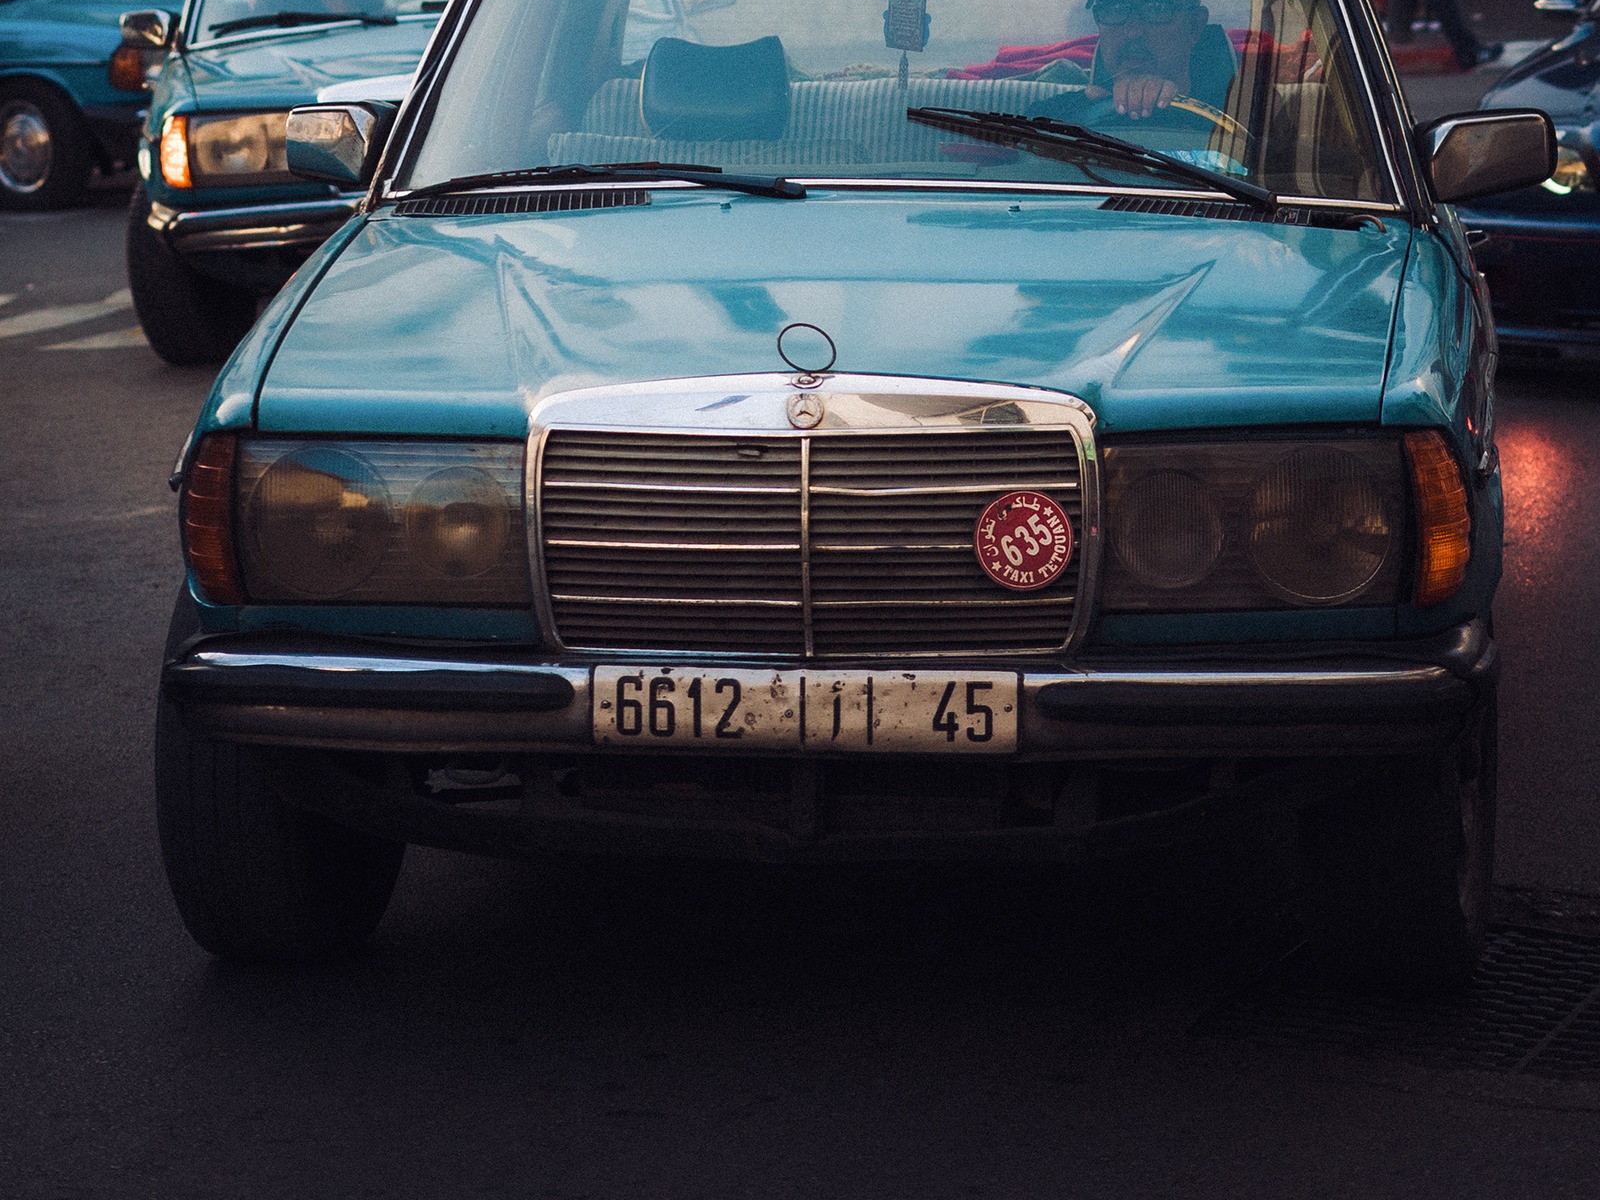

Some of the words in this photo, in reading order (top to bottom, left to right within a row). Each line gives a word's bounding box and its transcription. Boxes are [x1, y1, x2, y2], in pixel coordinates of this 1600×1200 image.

[997, 496, 1040, 521] طاكي
[1000, 513, 1053, 566] 635
[1002, 564, 1035, 583] TAXI
[1037, 515, 1067, 578] TETOUAN
[615, 675, 744, 738] 6612
[932, 681, 993, 742] 45
